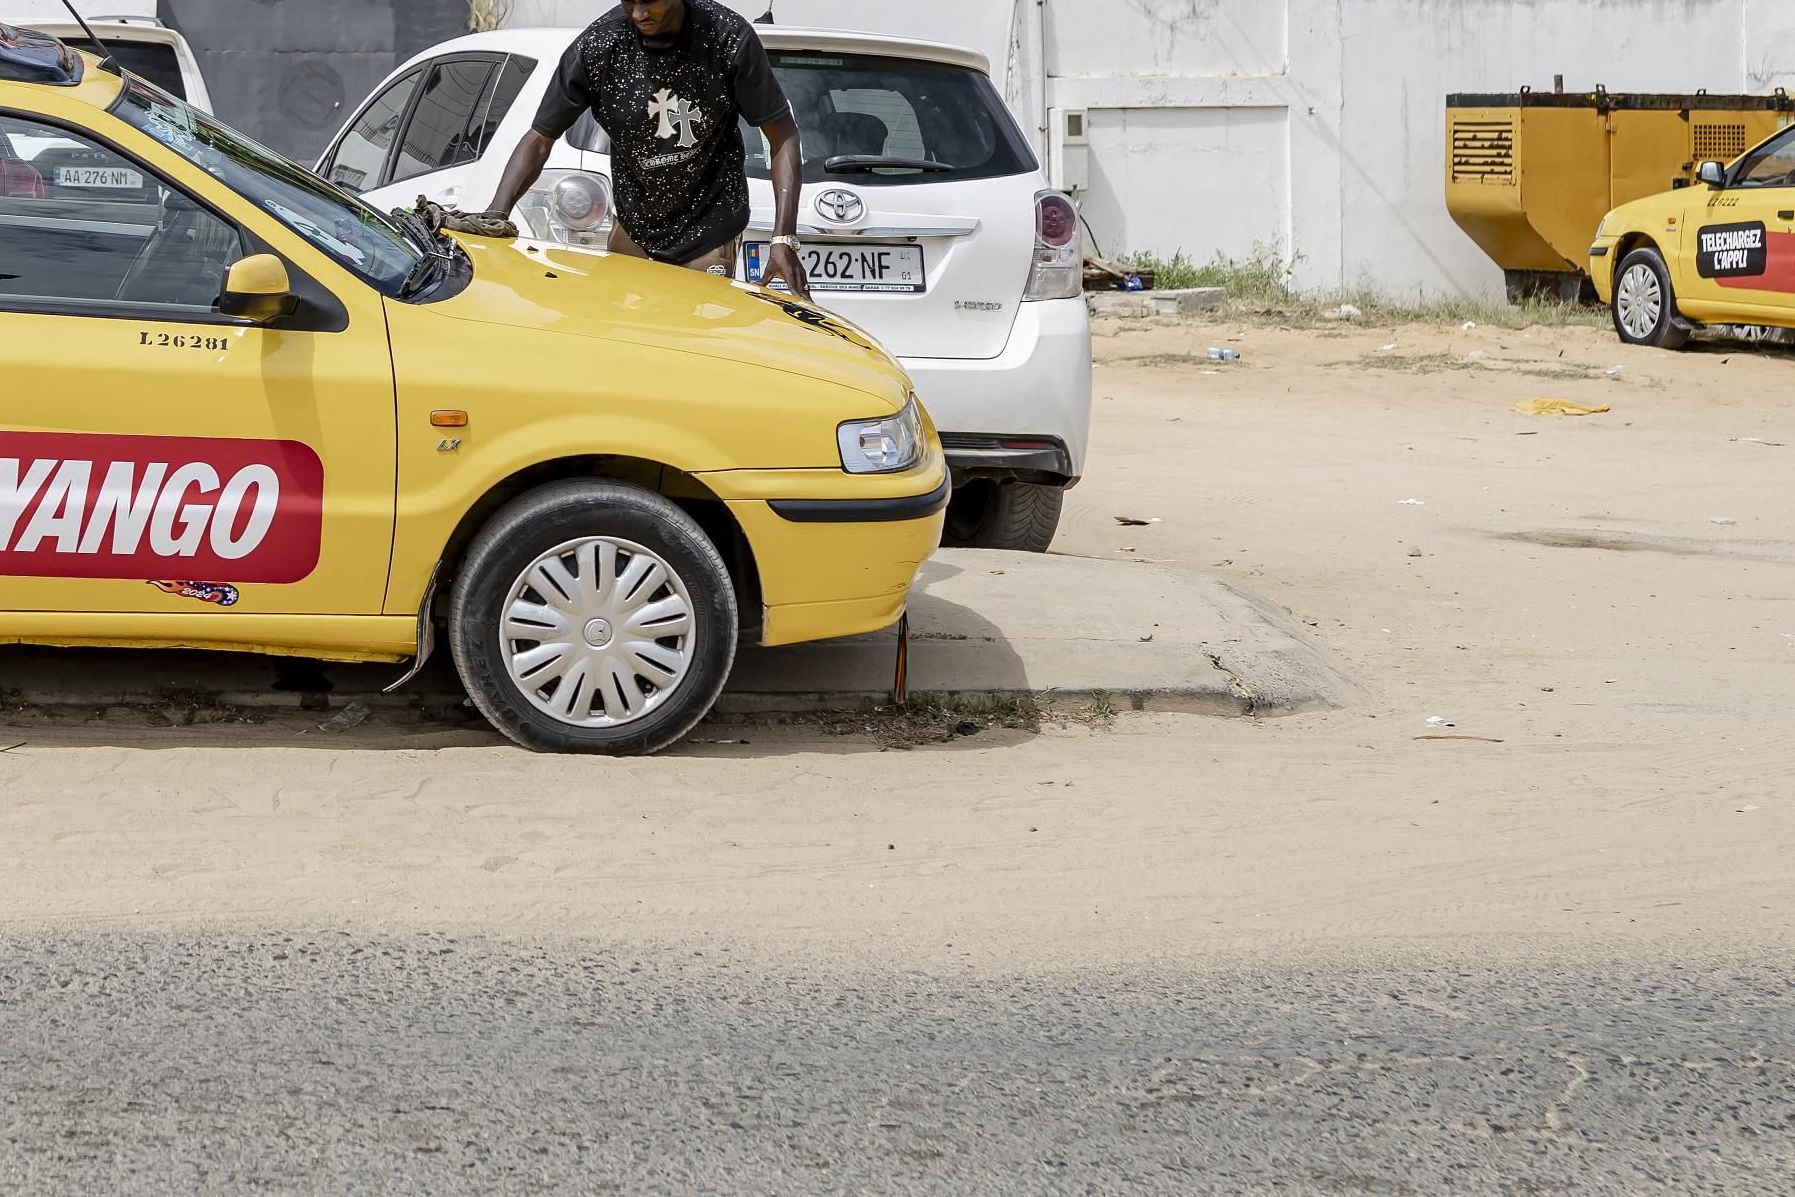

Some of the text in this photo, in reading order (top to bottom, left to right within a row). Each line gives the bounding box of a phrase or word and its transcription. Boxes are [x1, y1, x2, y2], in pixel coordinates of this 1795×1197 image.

[1701, 229, 1762, 252] TELECHARGEZ
[1714, 249, 1748, 271] L'APPLI
[750, 268, 760, 277] SN
[139, 331, 229, 351] L26281
